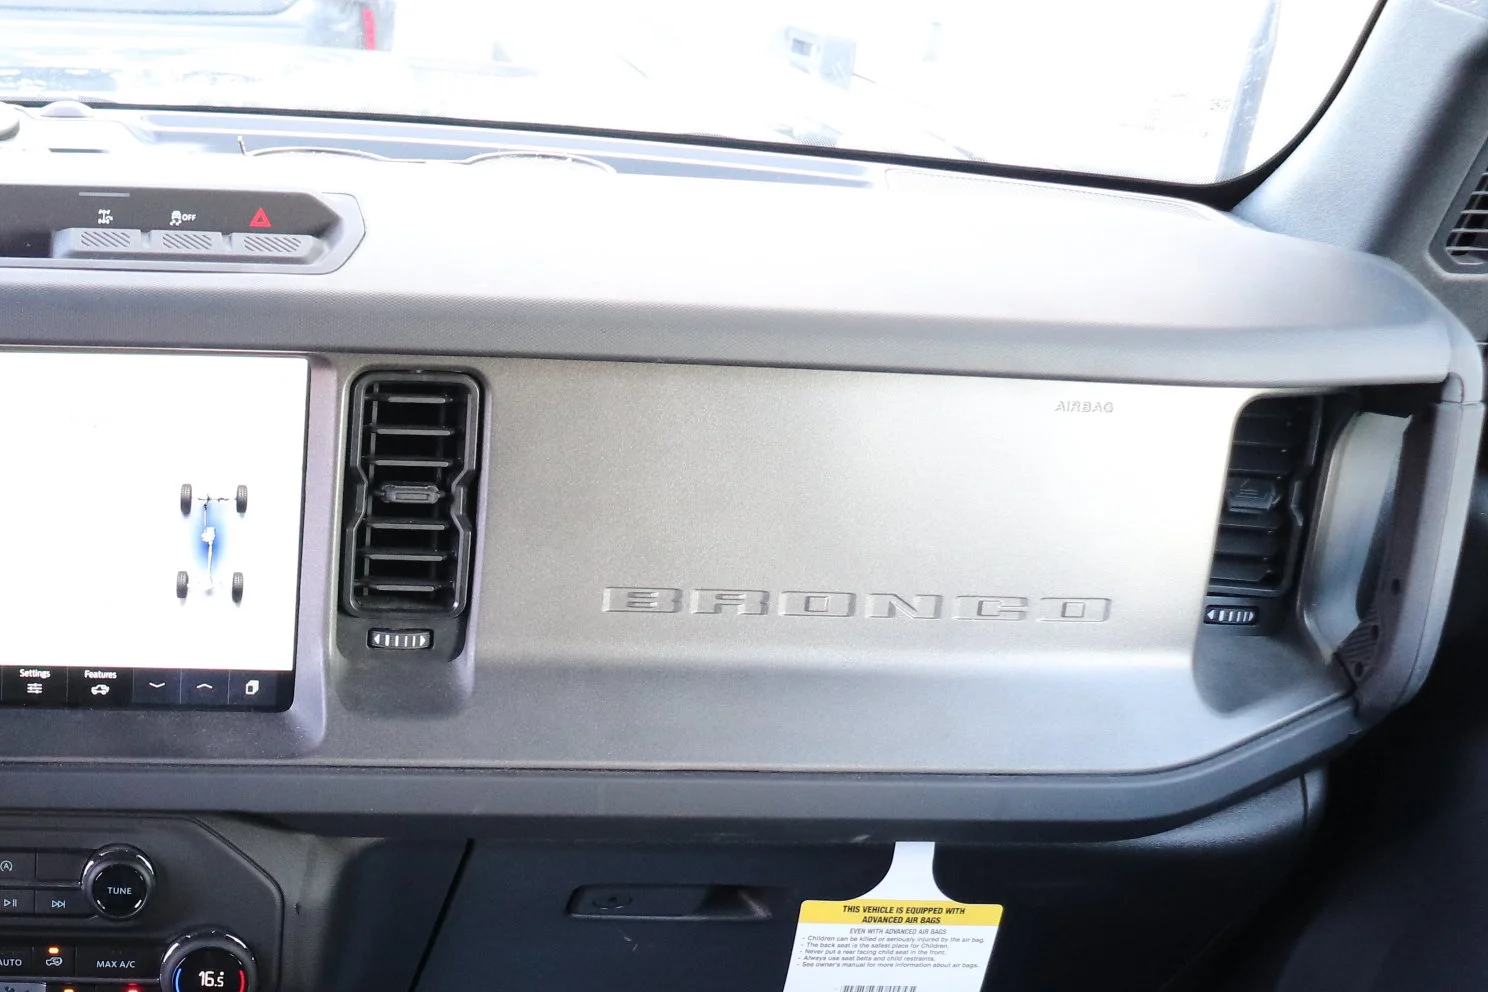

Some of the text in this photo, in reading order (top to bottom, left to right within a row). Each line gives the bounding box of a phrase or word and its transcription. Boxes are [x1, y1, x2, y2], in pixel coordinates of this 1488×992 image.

[182, 213, 197, 222] OFF
[1054, 400, 1114, 413] AIRBAG
[601, 586, 1112, 623] BRONCO
[19, 668, 51, 679] Settings
[84, 669, 117, 679] Features
[107, 886, 133, 895] TUNE
[842, 905, 966, 915] THIS VEHICLE IS EQUIPPED WITH
[861, 915, 941, 924] ADVANCED AIR BAGS
[96, 959, 136, 968] MAX A/C
